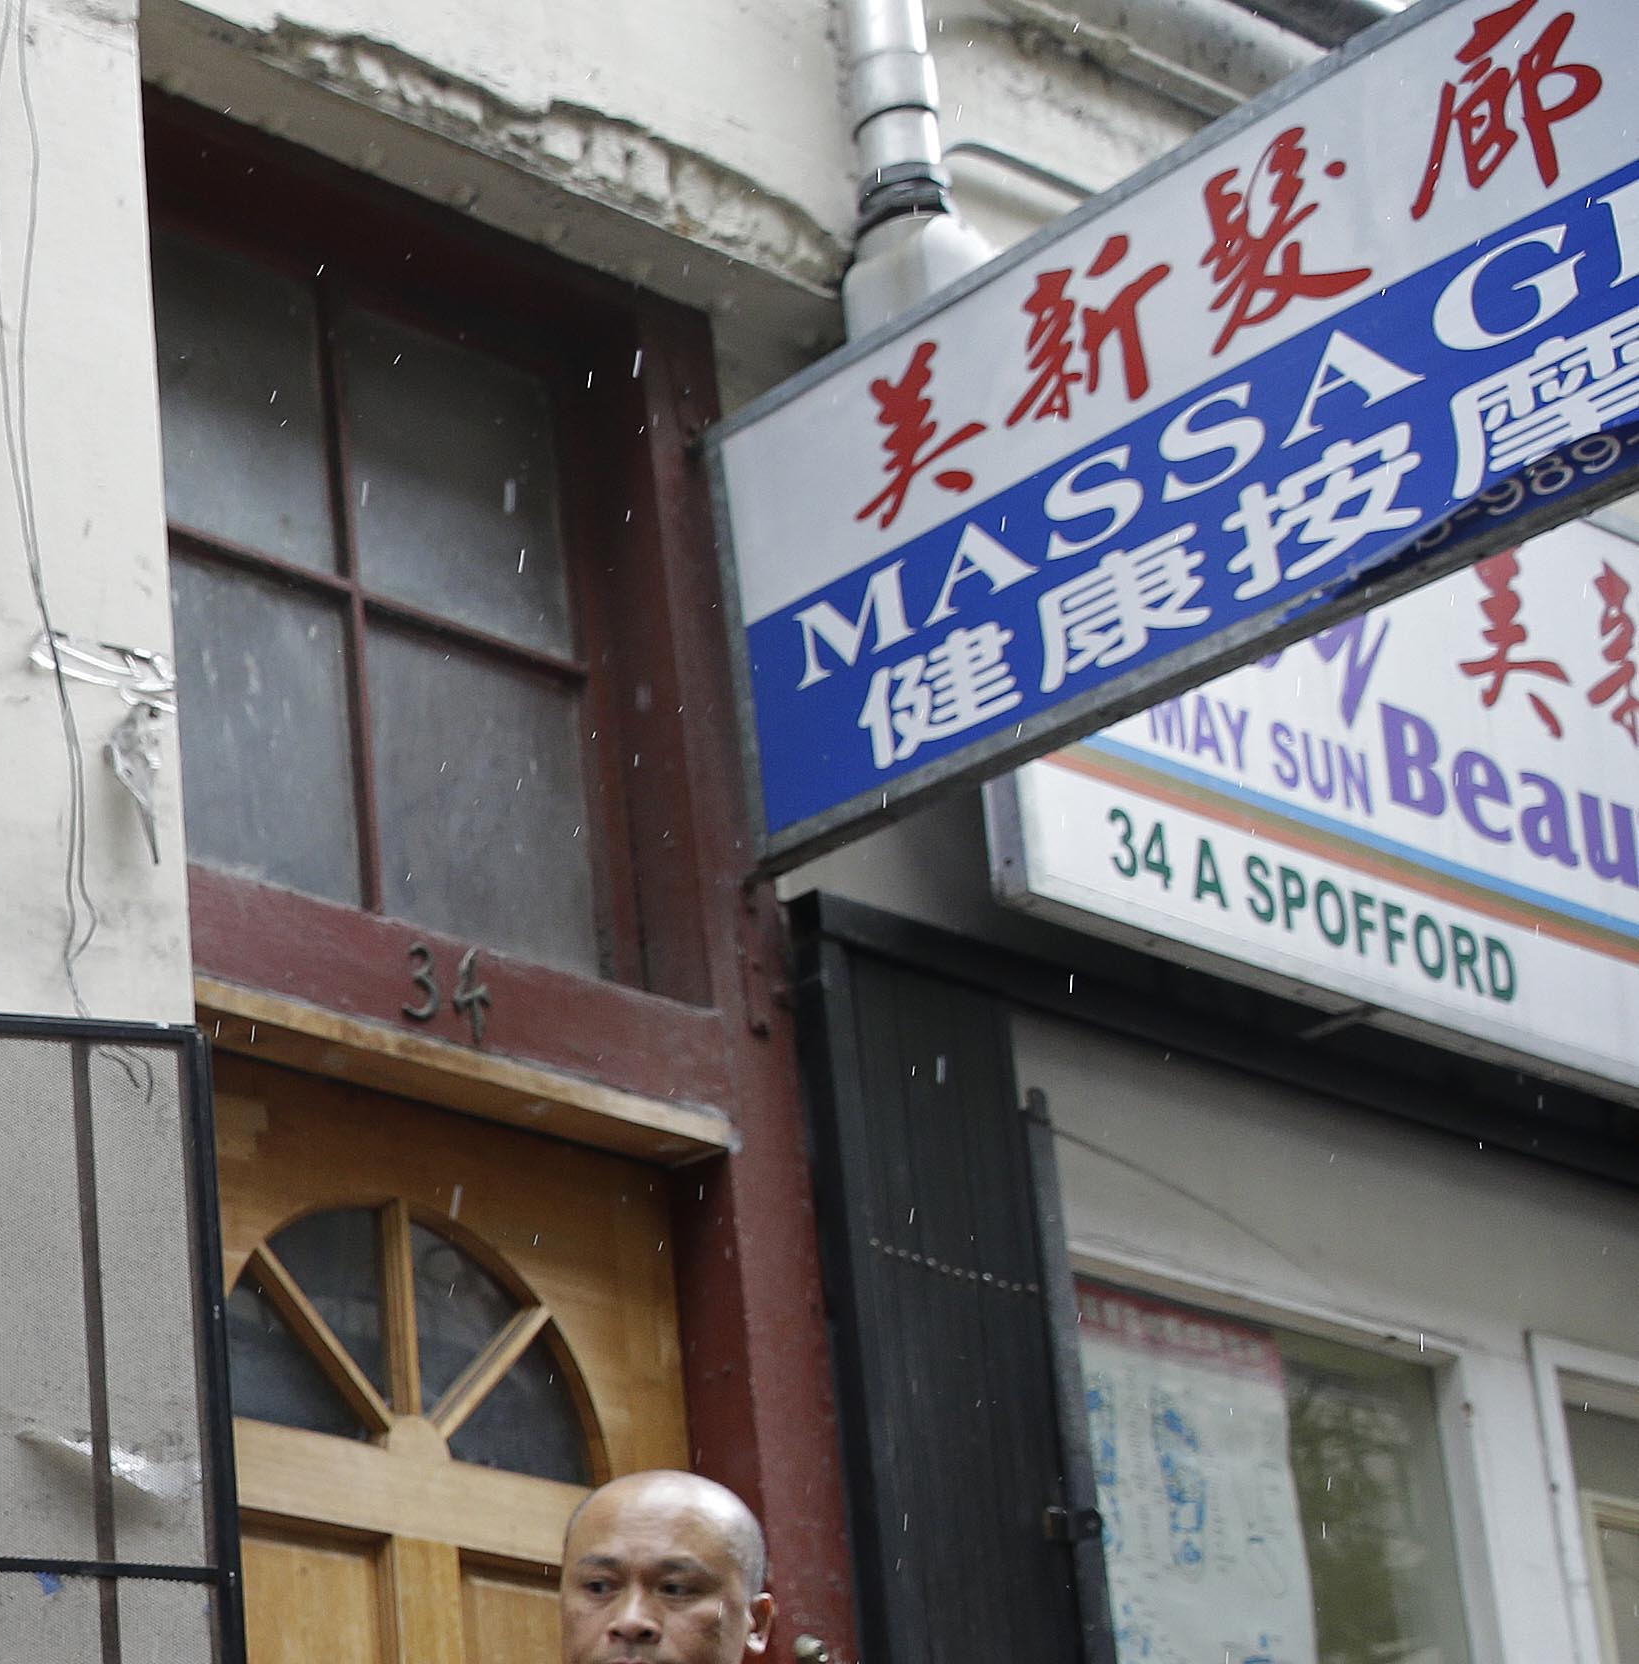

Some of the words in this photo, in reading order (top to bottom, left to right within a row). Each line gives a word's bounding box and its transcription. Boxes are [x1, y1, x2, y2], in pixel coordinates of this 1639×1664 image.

[1149, 693, 1249, 772] MAY
[1270, 720, 1373, 818] SUN
[1378, 700, 1639, 889] Beau
[1107, 807, 1173, 890] 34
[1193, 837, 1228, 911] A
[1243, 853, 1517, 1003] SPOFFORD
[401, 940, 493, 1045] 34
